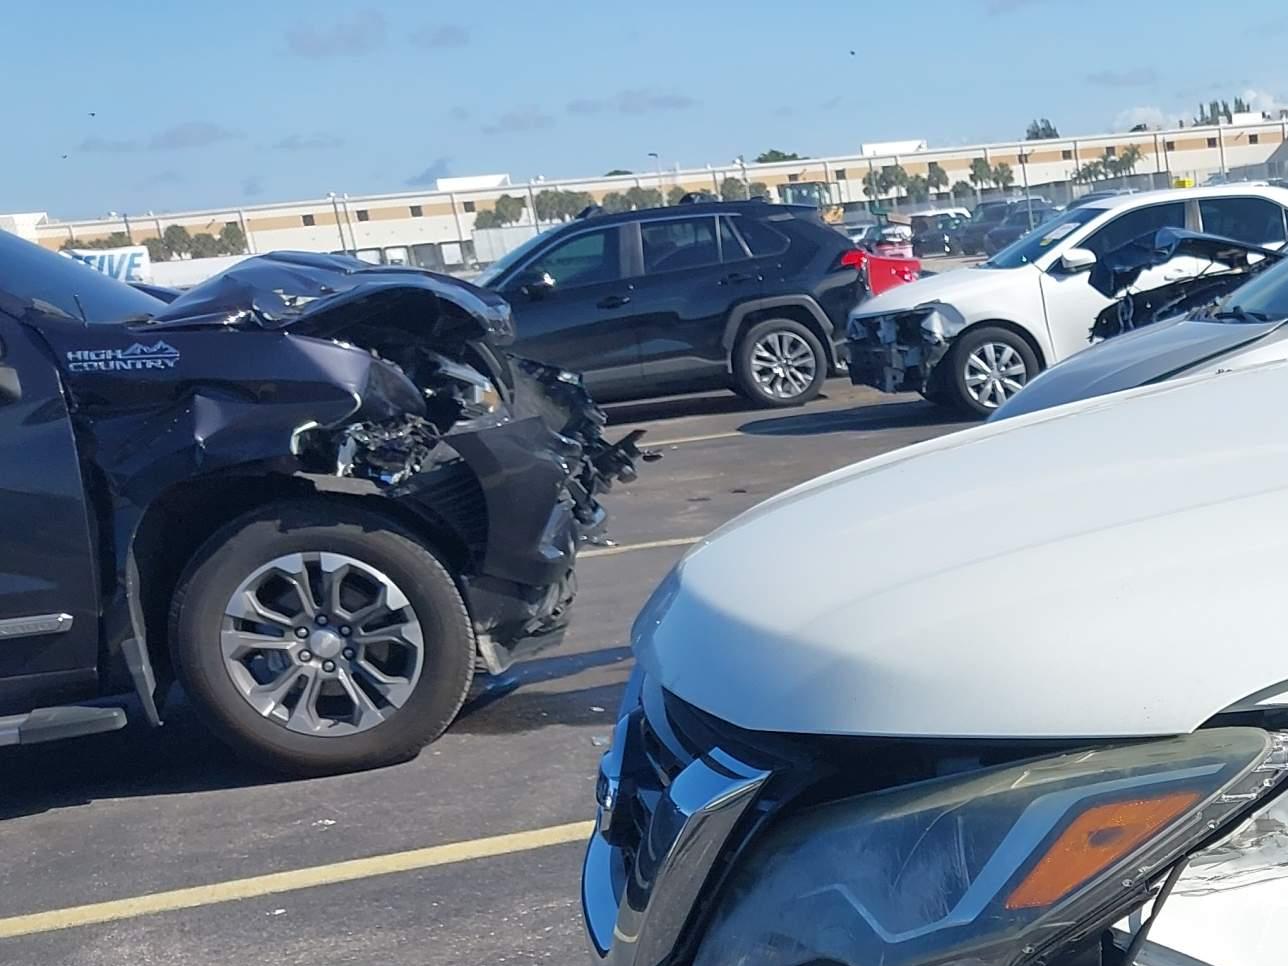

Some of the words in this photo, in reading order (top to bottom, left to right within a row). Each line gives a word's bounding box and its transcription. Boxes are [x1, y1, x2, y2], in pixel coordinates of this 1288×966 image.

[72, 251, 145, 282] IVE
[66, 349, 122, 361] HIGH
[68, 358, 176, 373] COUNTRY
